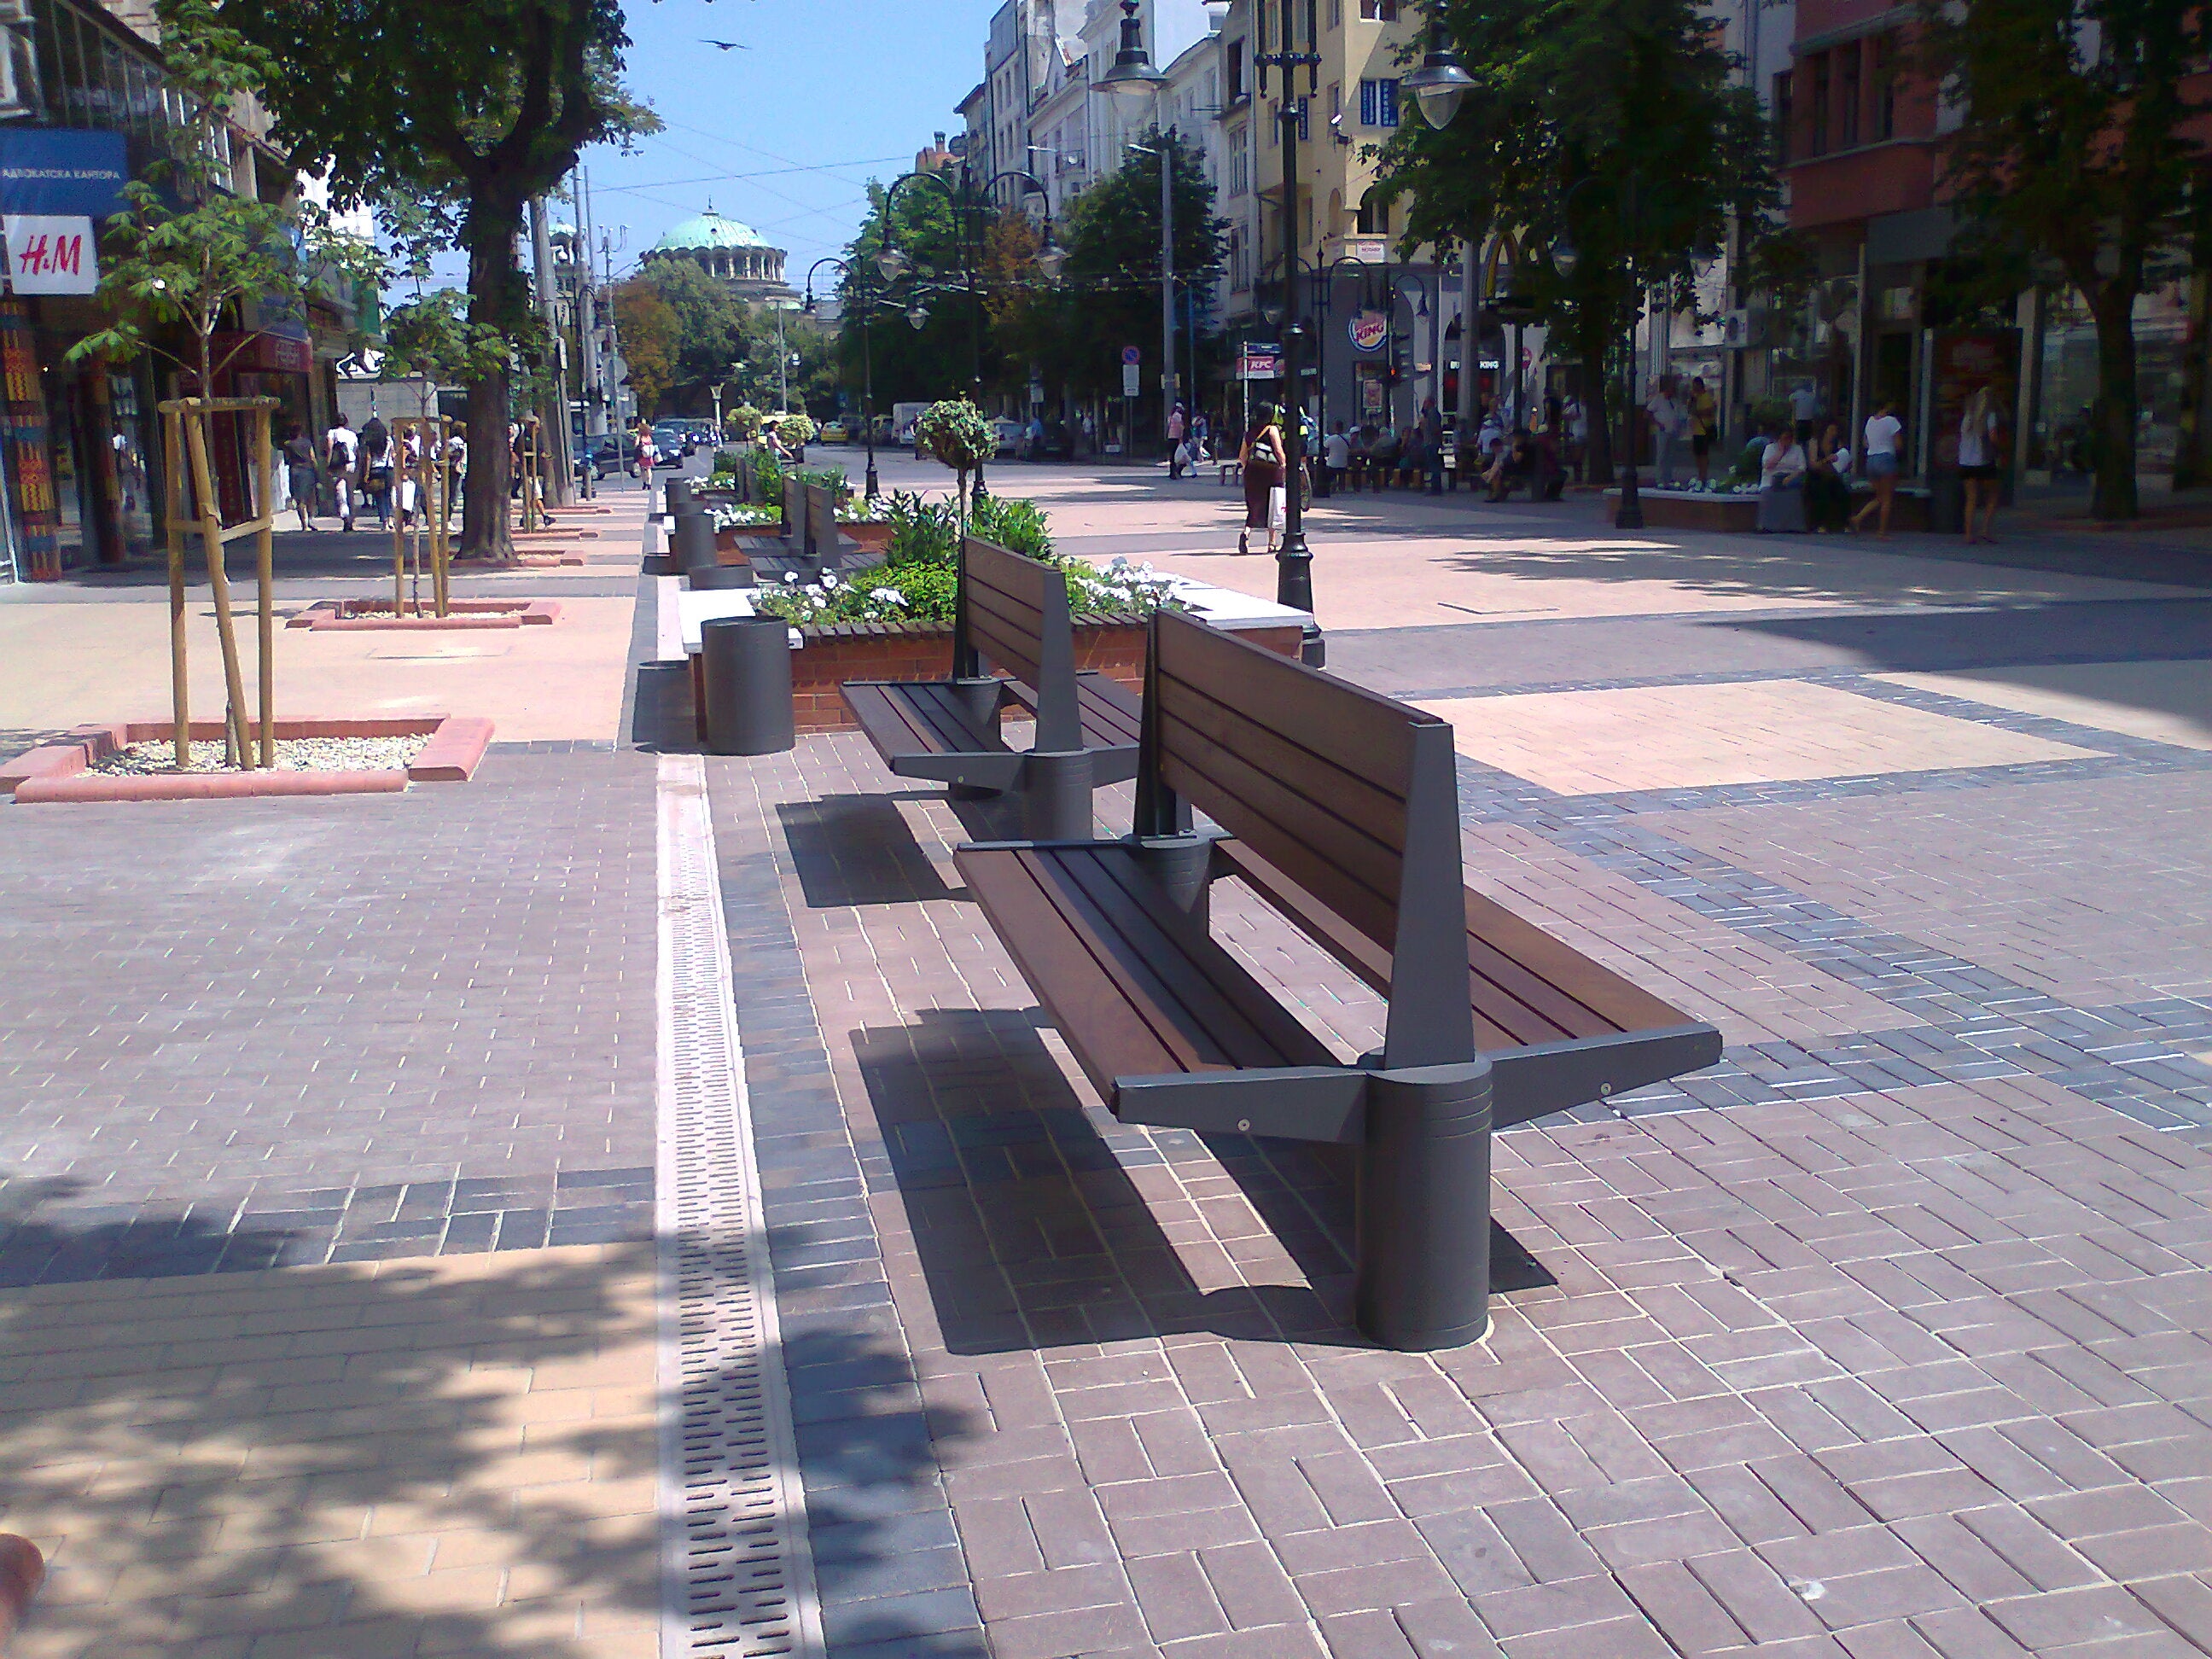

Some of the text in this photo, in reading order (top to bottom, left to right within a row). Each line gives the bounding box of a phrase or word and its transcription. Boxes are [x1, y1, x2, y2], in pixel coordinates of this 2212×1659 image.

[19, 235, 82, 276] H&M
[1353, 322, 1384, 342] KING
[1249, 359, 1272, 370] KFC
